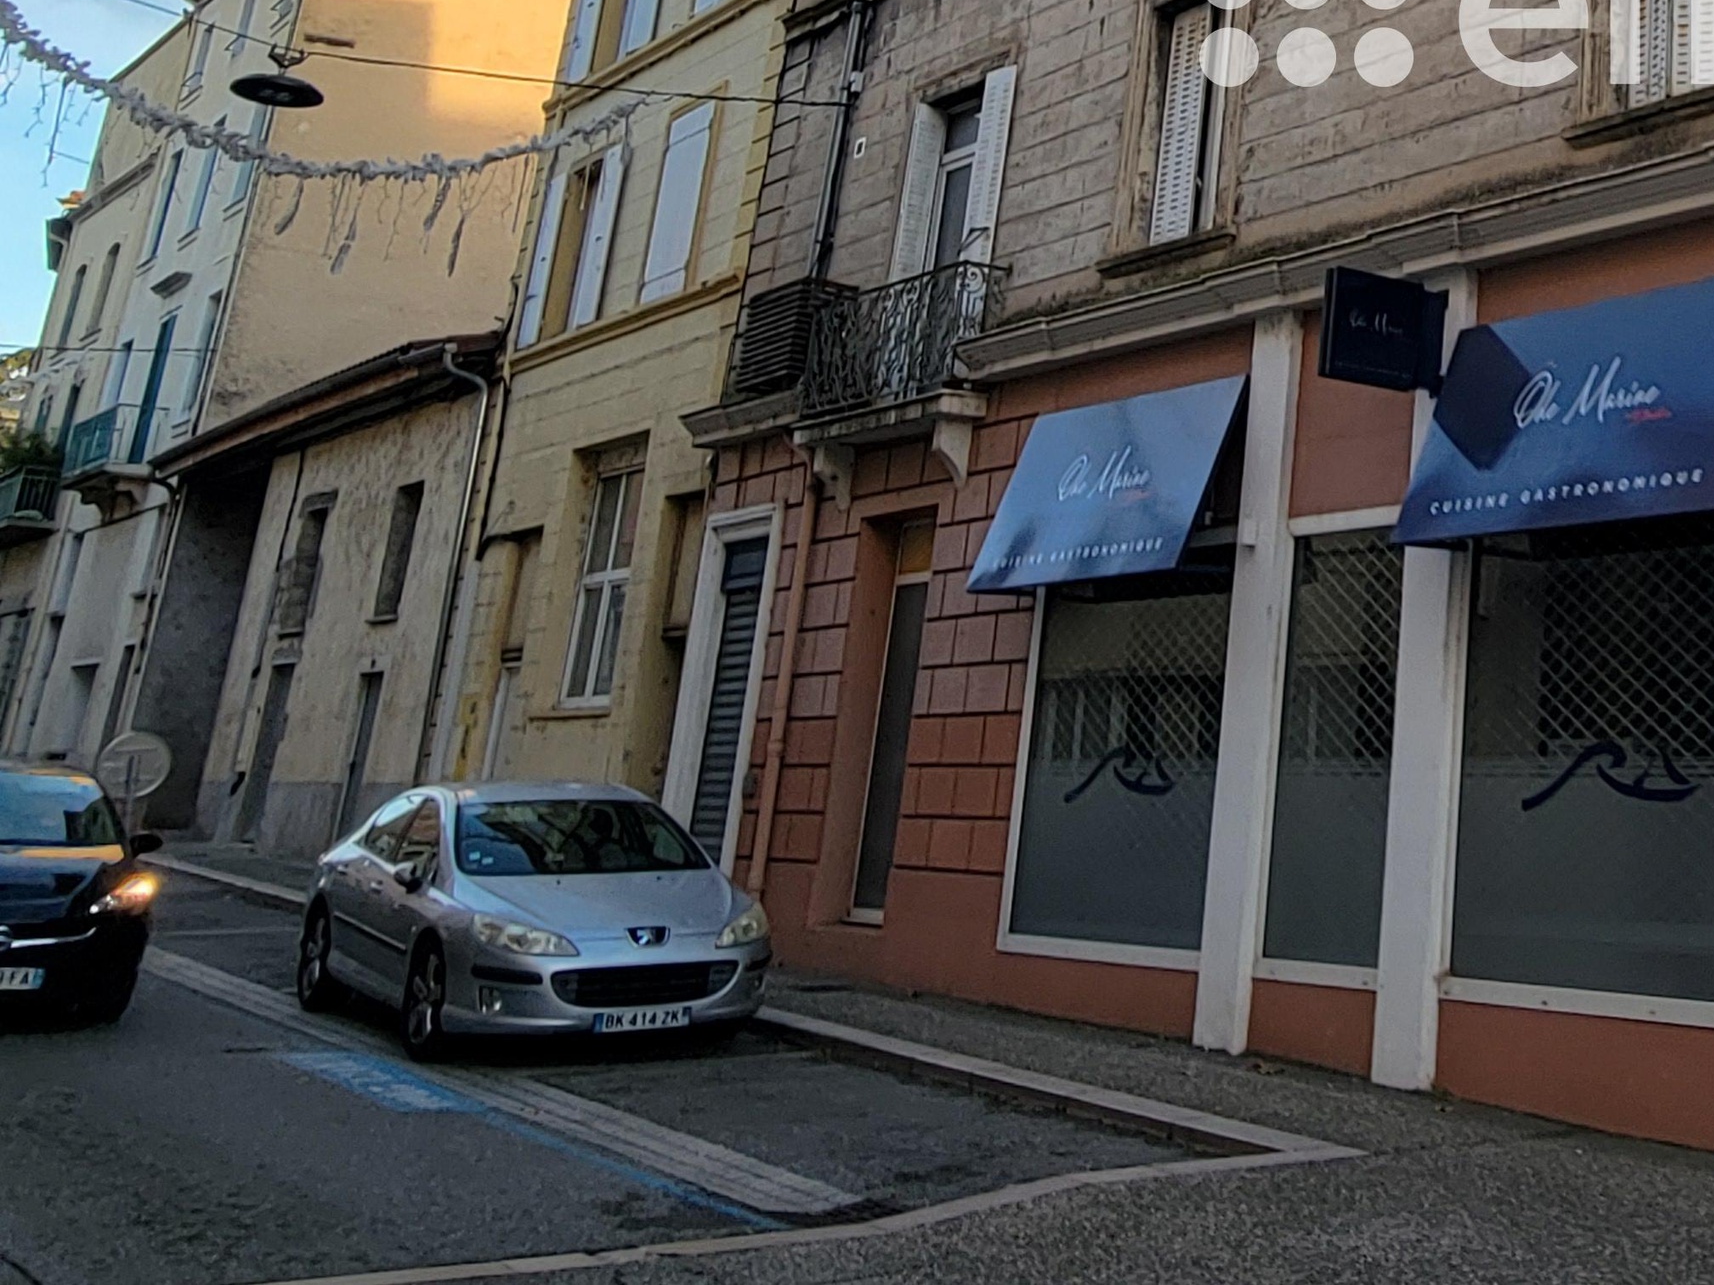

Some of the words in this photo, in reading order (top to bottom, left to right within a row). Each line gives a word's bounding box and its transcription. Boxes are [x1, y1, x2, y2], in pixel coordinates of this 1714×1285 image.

[1428, 491, 1509, 516] CUISINE
[1519, 467, 1703, 506] GASTRONOMIQUE
[629, 1011, 657, 1027] 414
